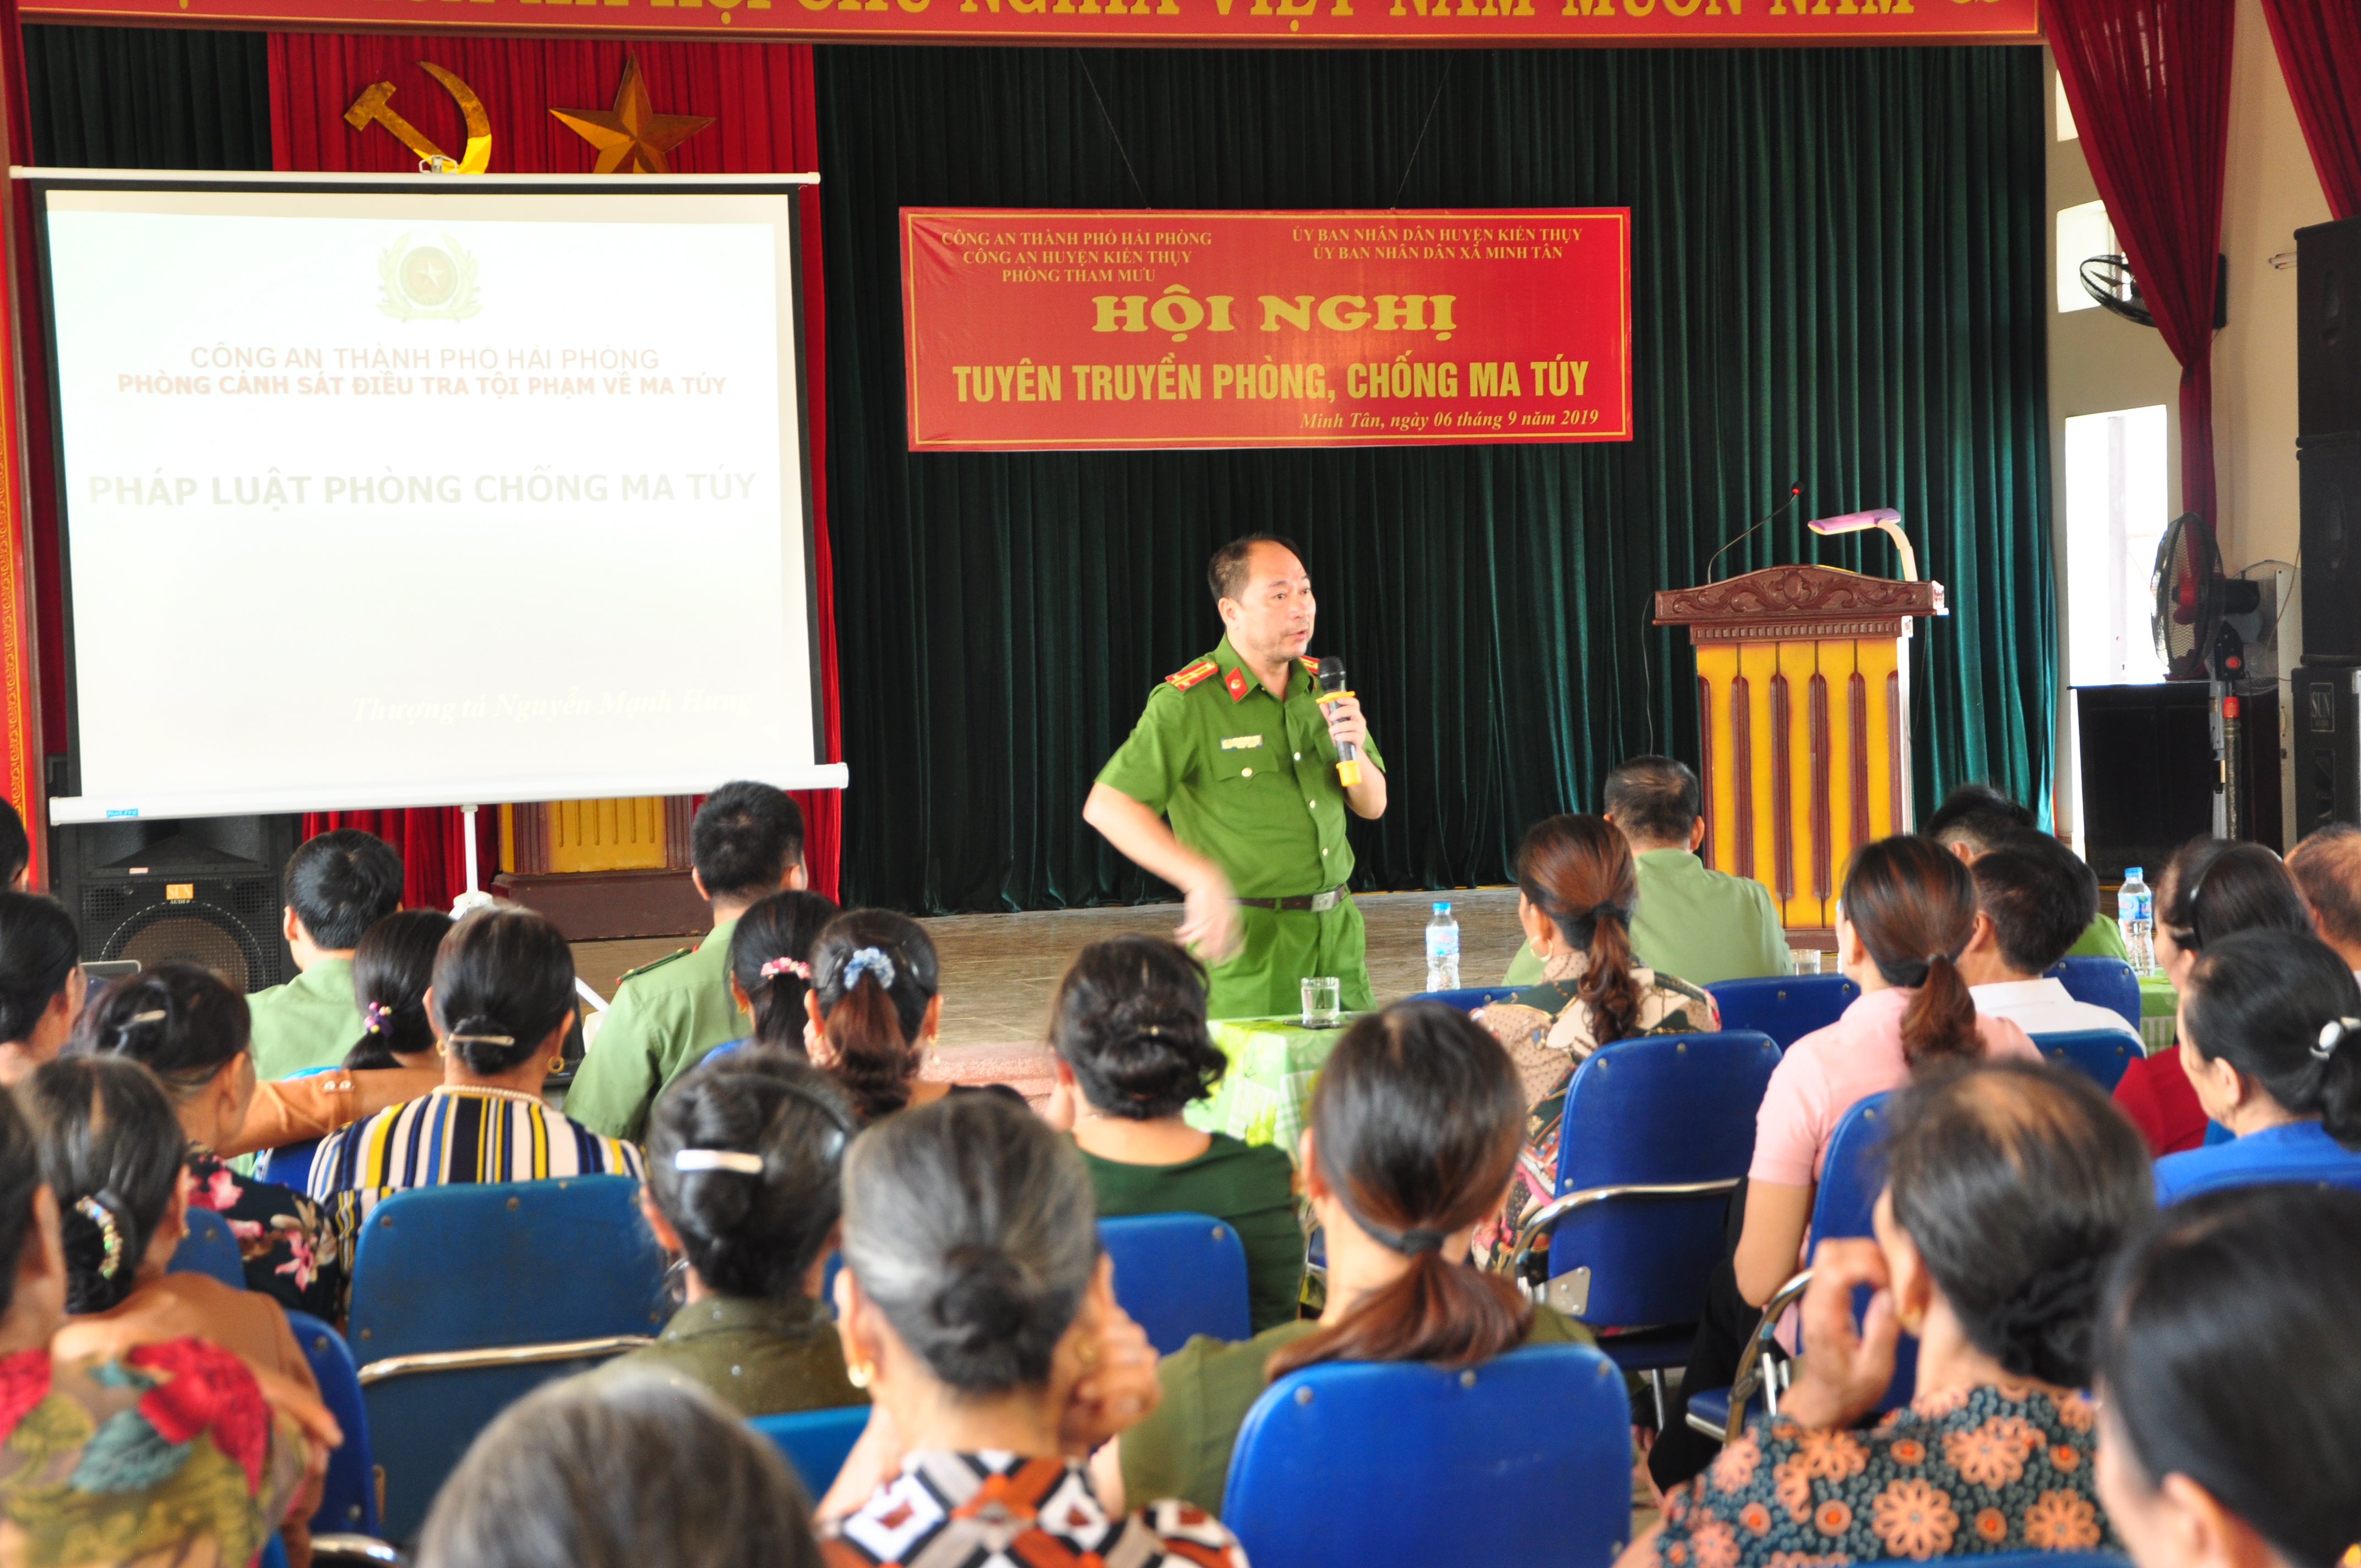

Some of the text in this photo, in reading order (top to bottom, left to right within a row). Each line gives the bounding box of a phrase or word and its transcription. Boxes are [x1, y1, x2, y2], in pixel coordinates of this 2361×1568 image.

[942, 227, 1211, 246] CÔNG AN THÀNH PHỐ HẢI PHÒNG
[1293, 224, 1582, 244] ỦY BAN NHÂN DÂN HUYỆN KIẾN THỤY
[964, 247, 1192, 266] CÔNG AN HUYỆN KIẾN THỤY
[1314, 243, 1563, 259] ỦY BAN NHÂN DÂN XÃ MINH TÂN
[1003, 265, 1155, 282] PHÒNG THAM MƯU
[1092, 284, 1456, 341] HỘI NGHỊ
[191, 341, 659, 369] CÔNG AN THÀNH PHỐ HẢI PHÒNG
[118, 369, 726, 399] PHÒNG CẢNH SÁT ĐIỀU TRA TỘI PHẠM VỀ MA TÚY
[953, 350, 1588, 402] TUYÊN TRUYỀN PHÒNG, CHỐNG MA TÚY
[1301, 409, 1598, 431] Minh Tân, ngày 06 tháng 9 năm 2019
[89, 464, 757, 512] PHÁP LUẬT PHÒNG CHỐNG MA TÚY
[353, 685, 753, 725] Thượng tá Nguyễn Mạnh Hưng
[168, 885, 192, 899] SUN
